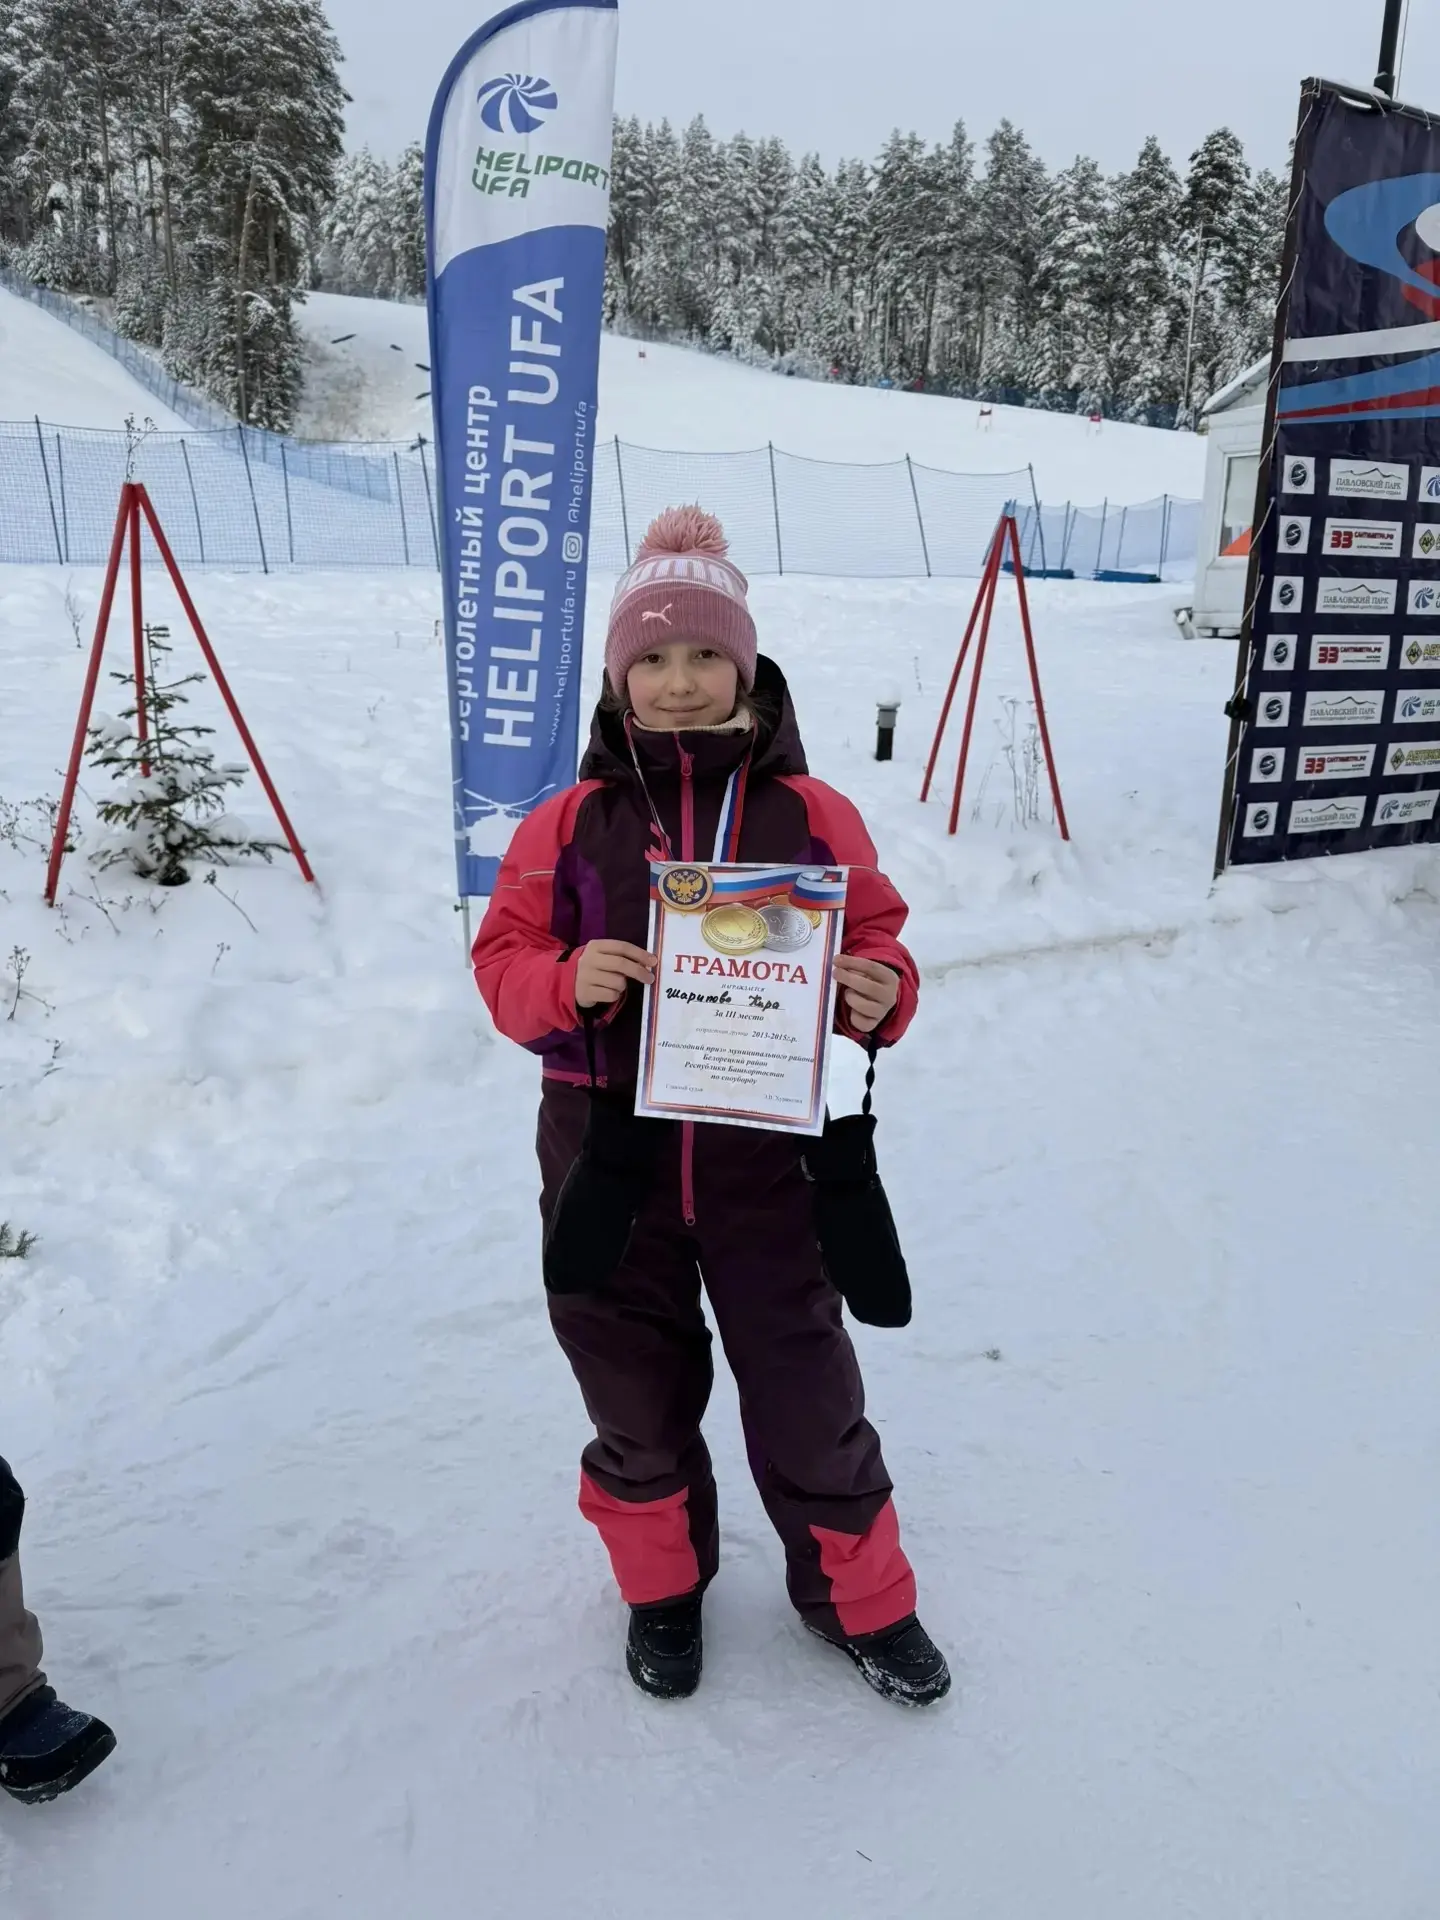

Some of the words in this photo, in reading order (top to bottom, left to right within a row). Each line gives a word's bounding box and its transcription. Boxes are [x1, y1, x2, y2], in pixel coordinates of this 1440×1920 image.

[475, 145, 610, 191] HELIPORT
[471, 168, 530, 198] UFA
[507, 276, 565, 405] UFA
[463, 385, 498, 494] центр
[568, 401, 588, 523] @heliportufa
[1336, 478, 1383, 489] ПАВЛОВСКИЙ
[1384, 481, 1402, 490] ПАРК
[1330, 530, 1353, 549] 33
[483, 424, 555, 748] HELIPORT
[1323, 595, 1370, 604] ПАВЛОВСКИЙ
[1371, 596, 1389, 605] ПАРК
[1318, 646, 1339, 663] 33
[1310, 707, 1357, 716] ПАВЛОВСКИЙ
[1359, 707, 1376, 715] ПАРК
[1304, 757, 1326, 774] 33
[673, 954, 808, 985] ГРАМОТА
[720, 983, 766, 992] НАГРАЖДАЕТСЯ
[713, 1009, 724, 1018] За
[724, 1010, 737, 1019] III
[737, 1013, 764, 1021] место
[658, 1040, 704, 1051] «Новогодний
[705, 1045, 727, 1054] приз»
[728, 1047, 787, 1059] муниципального
[788, 1054, 815, 1063] района
[684, 1061, 726, 1073] Республики
[728, 1065, 785, 1078] Башкортостан
[702, 1054, 745, 1066] Белорецкий
[745, 1058, 768, 1068] район
[721, 1075, 758, 1085] сноуборду
